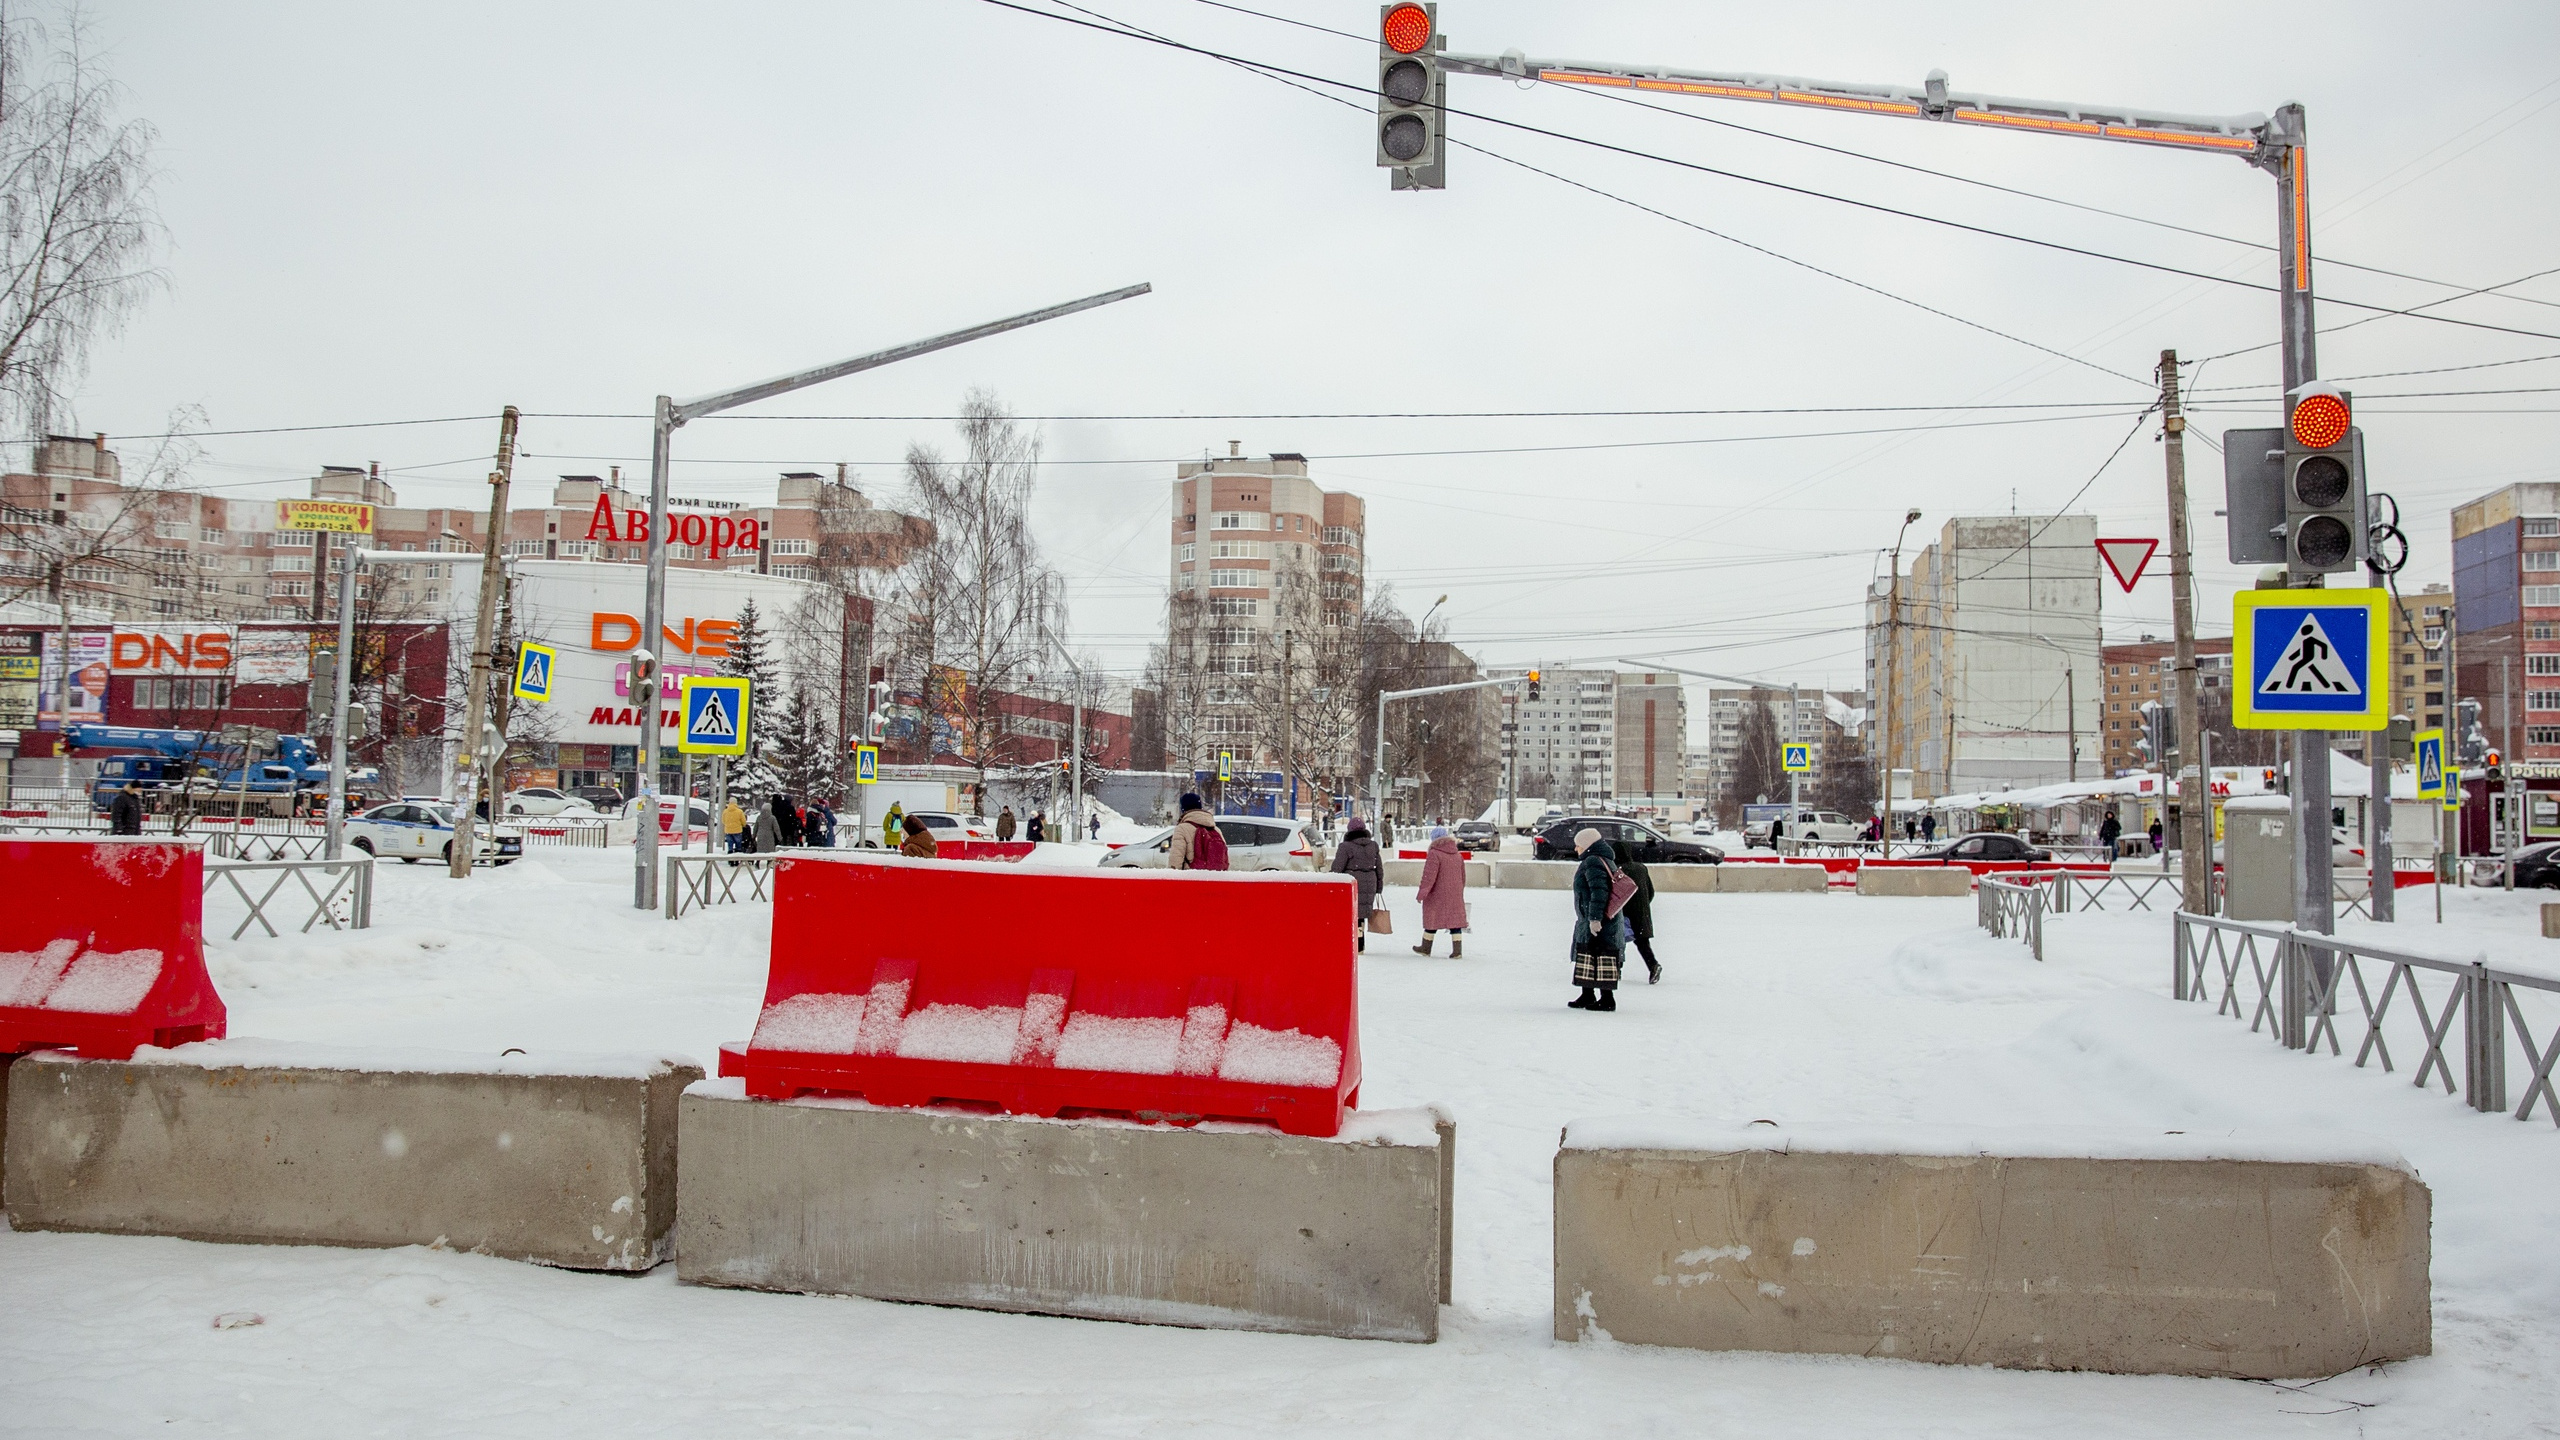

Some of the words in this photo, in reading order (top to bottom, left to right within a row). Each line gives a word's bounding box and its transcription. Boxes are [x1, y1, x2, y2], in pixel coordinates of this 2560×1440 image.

[291, 503, 358, 514] КОЛЯСКИ
[640, 495, 700, 507] ТООВЫЙ
[708, 501, 741, 510] ЦЕНТР
[591, 612, 740, 657] DNS
[113, 633, 233, 669] DNS
